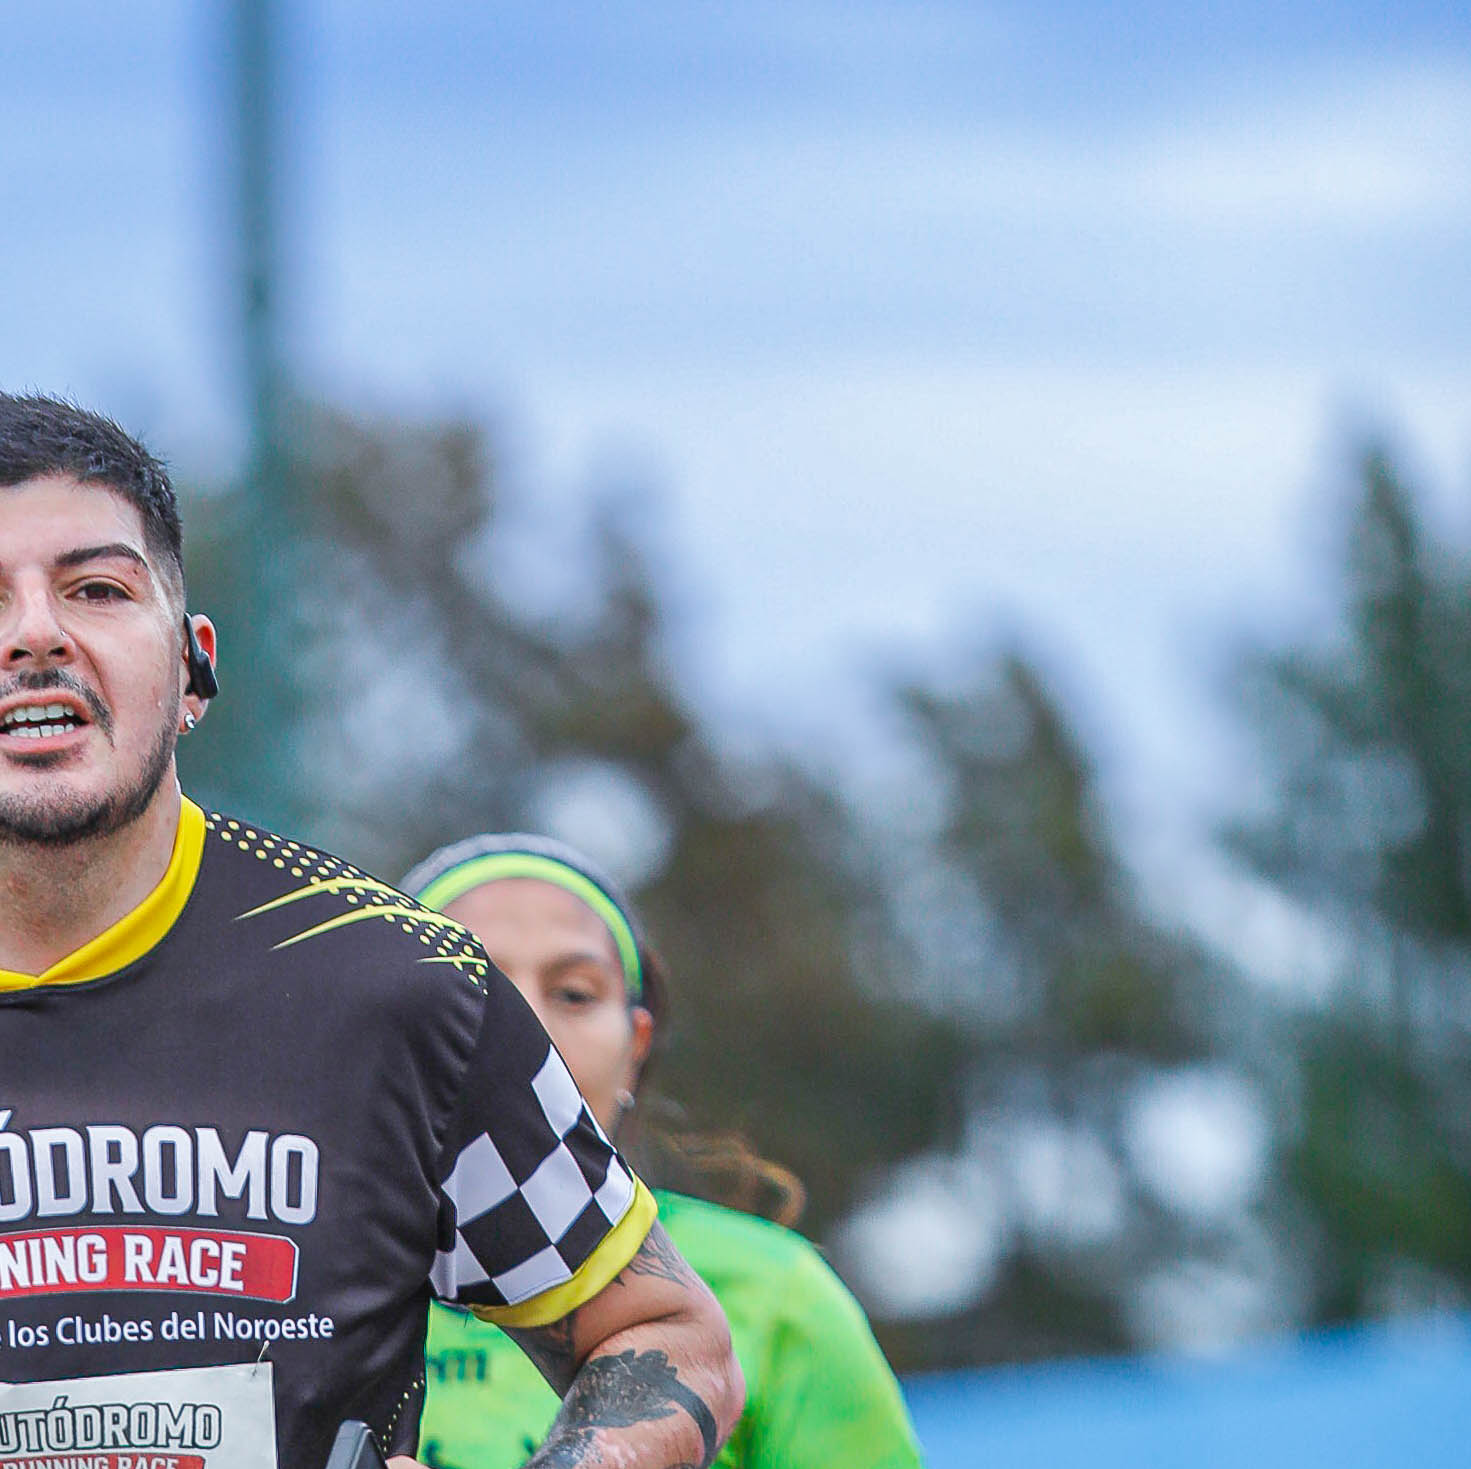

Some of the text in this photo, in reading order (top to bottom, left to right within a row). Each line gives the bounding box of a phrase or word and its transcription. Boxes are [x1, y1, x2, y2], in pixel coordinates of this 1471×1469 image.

[123, 1234, 247, 1292] RACE
[8, 1319, 49, 1348] los
[55, 1314, 153, 1345] Clubes
[160, 1312, 206, 1340] del
[213, 1312, 335, 1340] Noroeste
